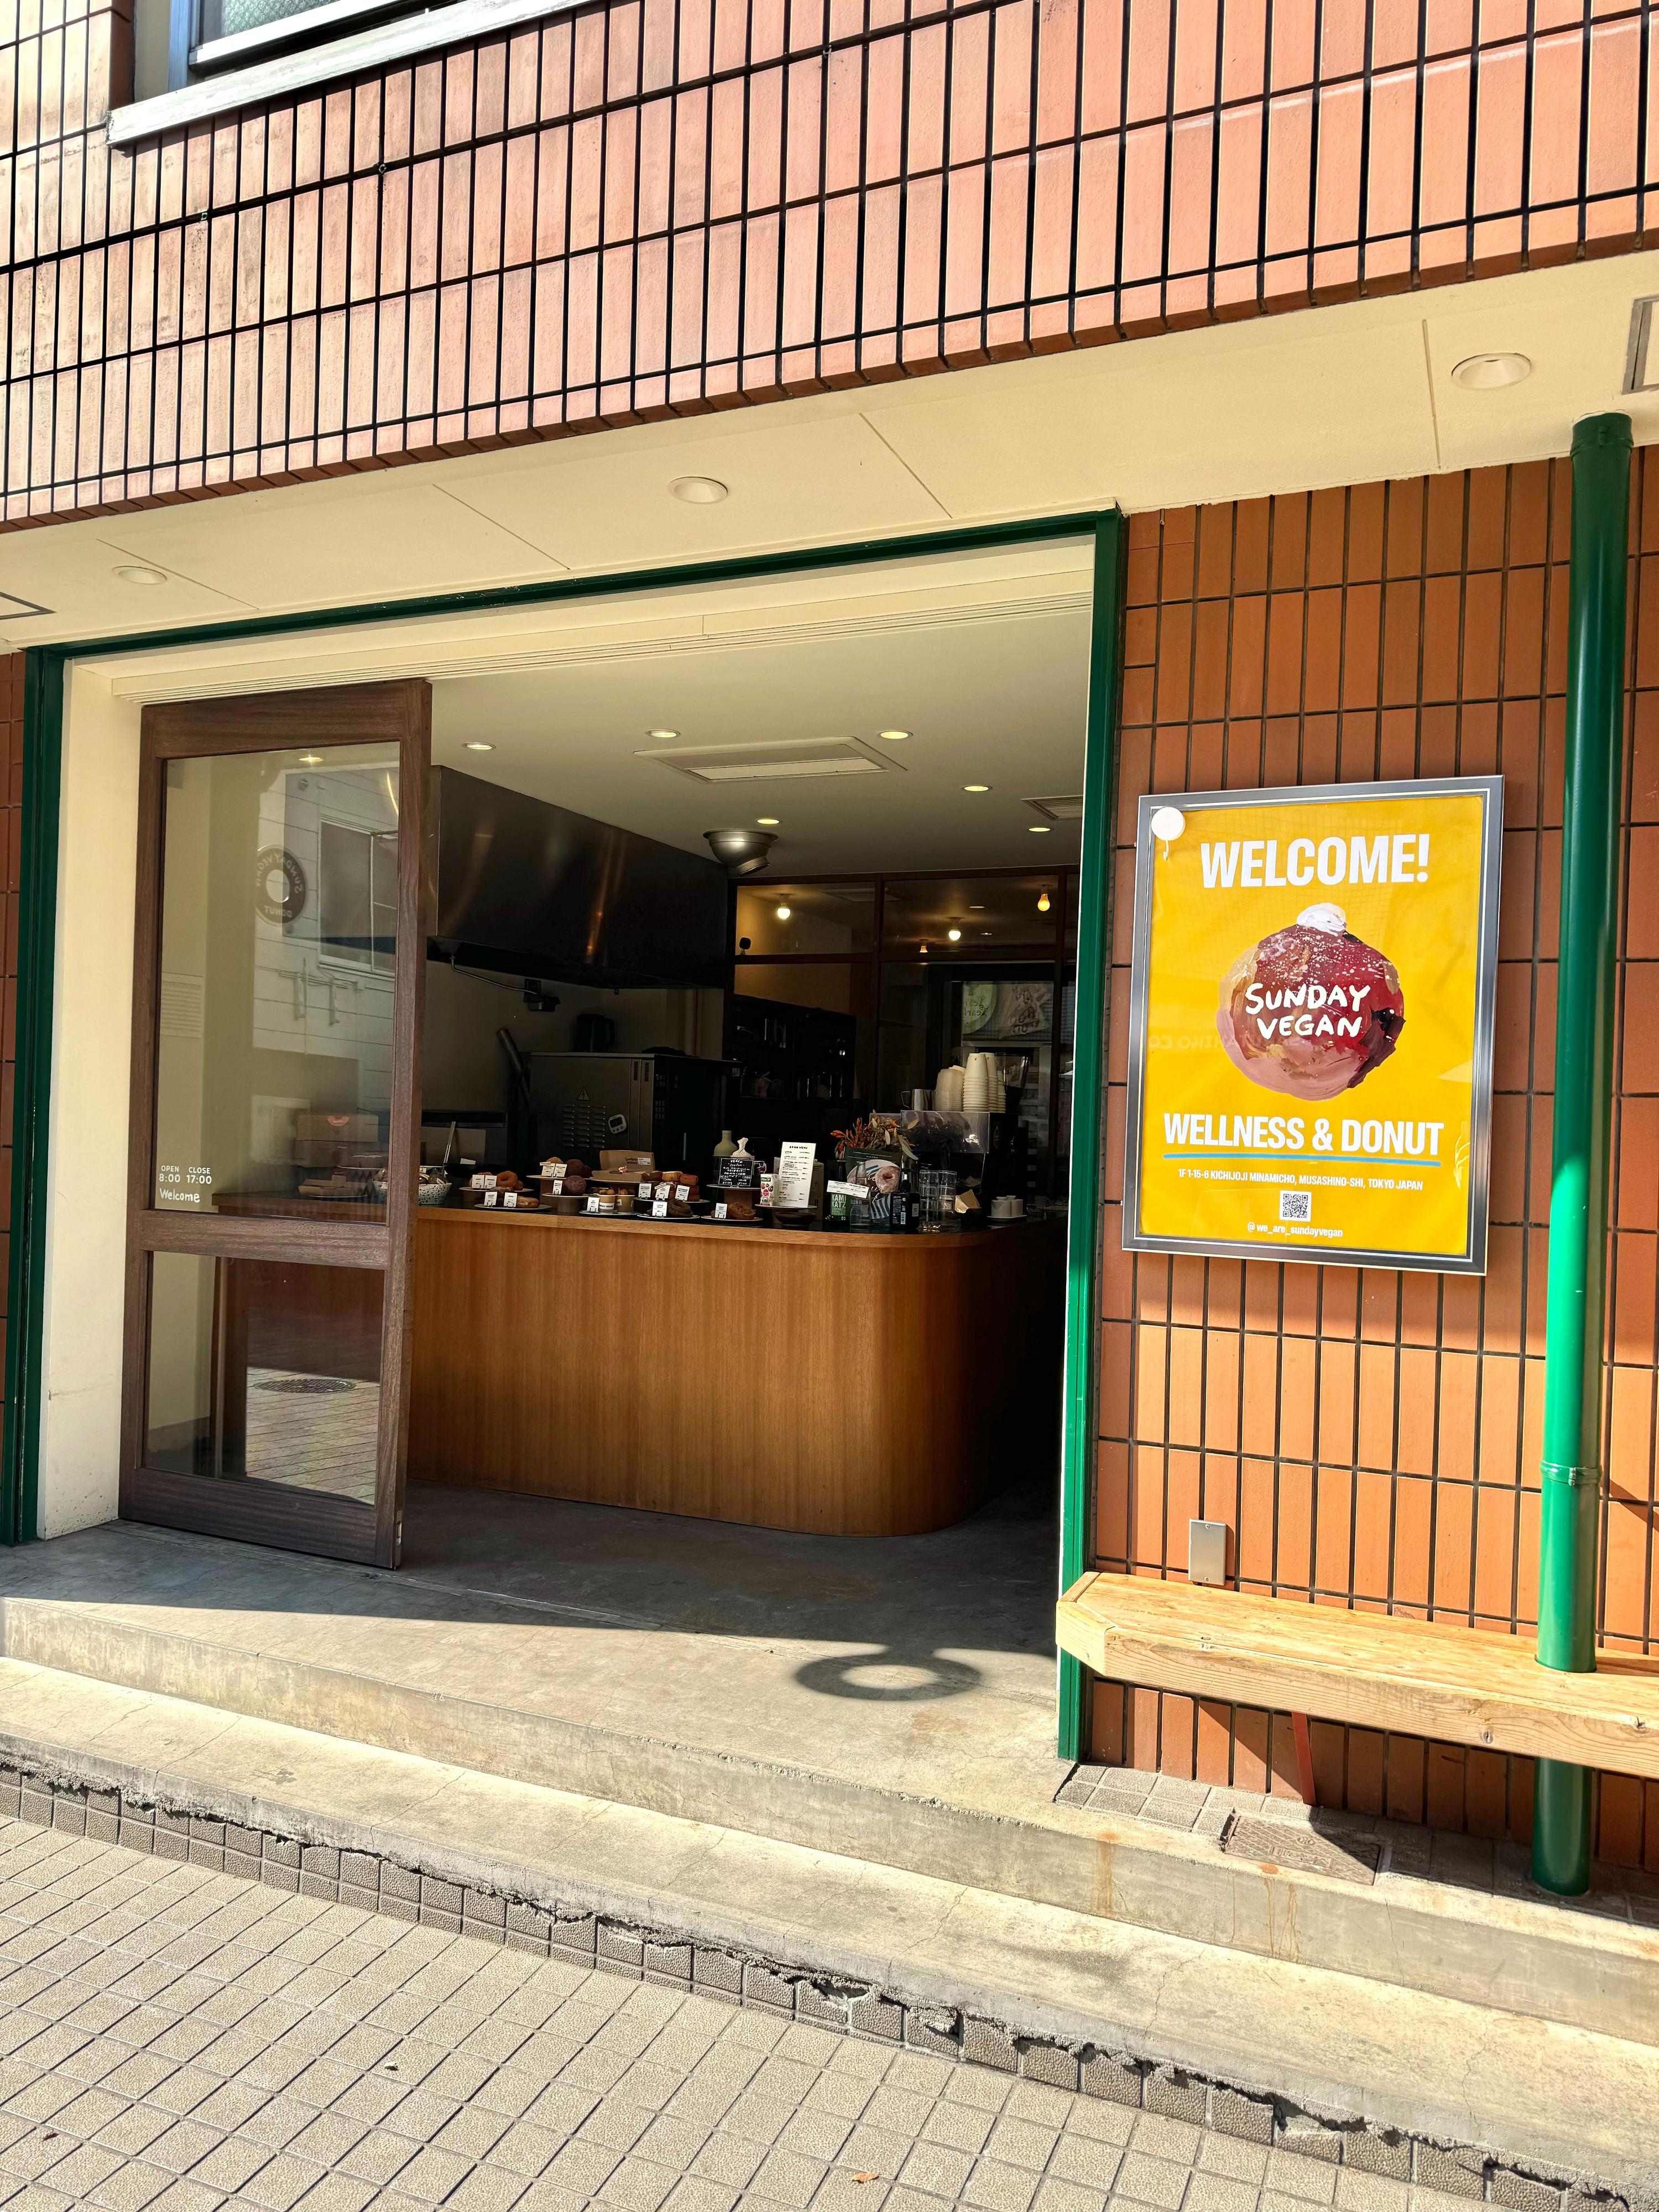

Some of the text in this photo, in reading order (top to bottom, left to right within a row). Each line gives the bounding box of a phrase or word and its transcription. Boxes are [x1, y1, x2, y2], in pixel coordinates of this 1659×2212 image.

[1201, 833, 1431, 889] WELCOME!
[1245, 983, 1371, 1015] SUNDAY
[1256, 1014, 1363, 1040] VEGAN
[1164, 1113, 1444, 1156] WELLNESS & DONUT
[159, 1173, 212, 1185] 8:00 17:00
[188, 1166, 211, 1175] CLOSE
[1178, 1168, 1186, 1177] 1F
[1210, 1170, 1248, 1181] KICHIJOJI
[1249, 1172, 1297, 1186] MINAMICHO,
[1298, 1175, 1366, 1190] MUSASHINO-SHI,
[1368, 1178, 1395, 1189] TOKYO
[1395, 1180, 1423, 1191] JAPAN
[159, 1187, 201, 1204] Welcome
